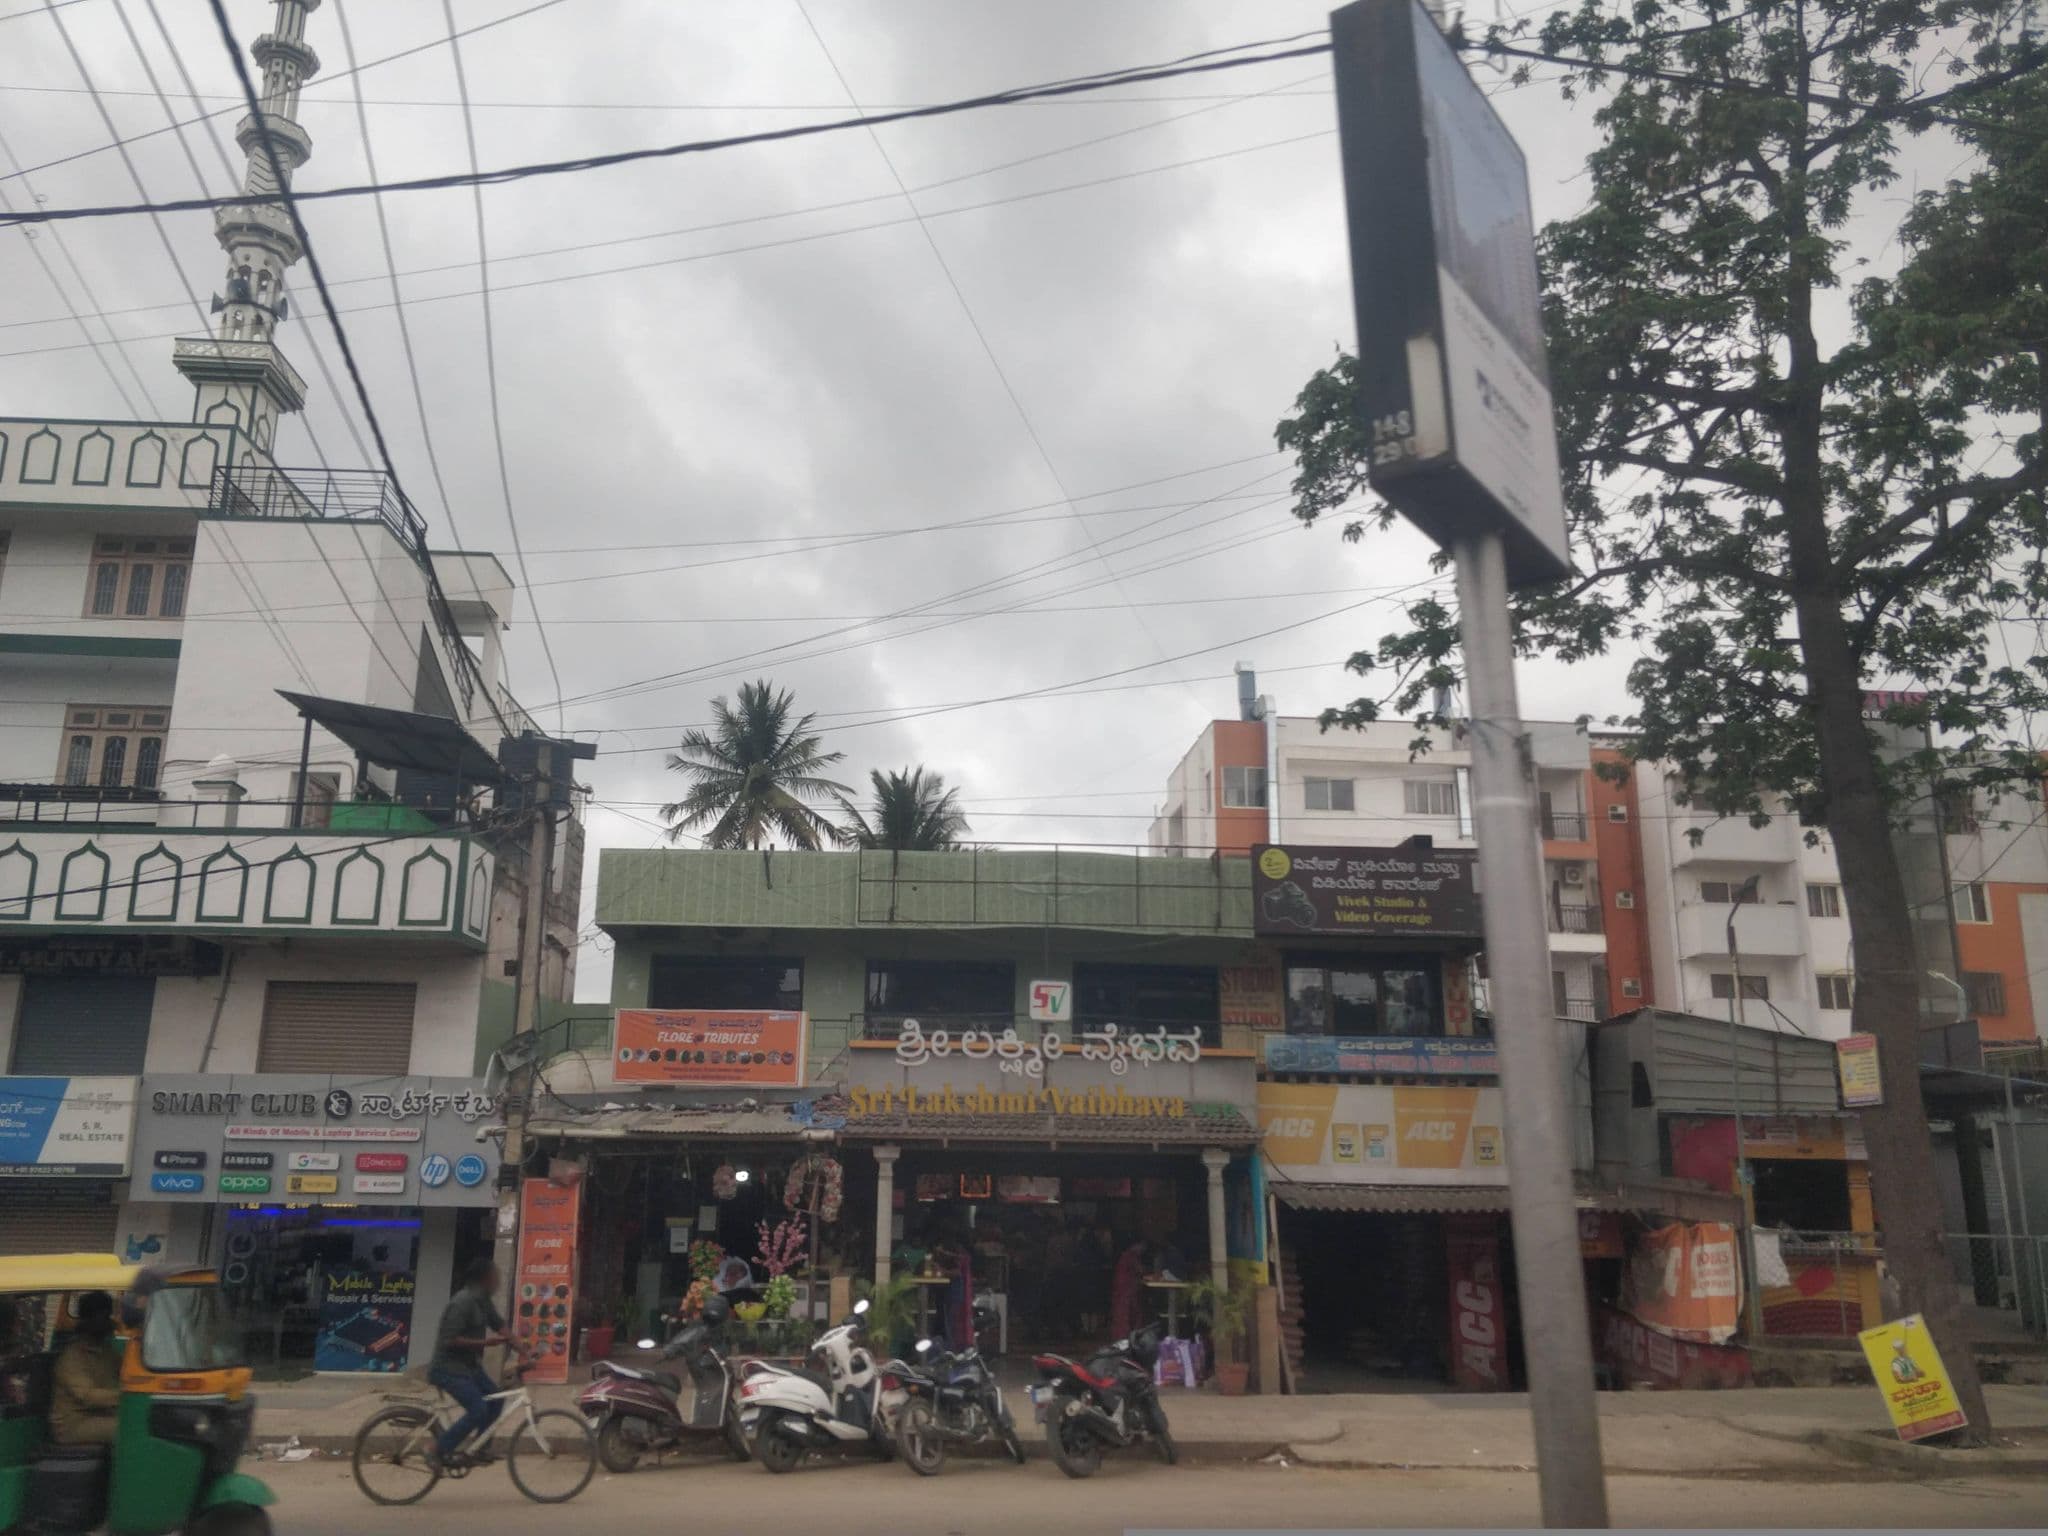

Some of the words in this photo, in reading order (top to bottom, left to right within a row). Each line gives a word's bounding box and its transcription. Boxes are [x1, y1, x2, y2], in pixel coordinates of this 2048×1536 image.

[1337, 896, 1370, 907] Vivek
[1374, 897, 1414, 908] Studio
[1418, 897, 1427, 908] &
[1334, 911, 1370, 923] Video
[1373, 911, 1433, 926] Coverage
[657, 1031, 694, 1043] FLORE
[703, 1032, 760, 1044] TRIBUTES
[896, 1018, 951, 1066] ಶ್ರೀ
[1082, 1022, 1202, 1076] ವೈಭವ
[152, 1091, 241, 1114] SMART
[251, 1093, 316, 1115] CLUB
[849, 1082, 892, 1119] Sri
[902, 1081, 1037, 1114] Lakshmi
[1040, 1083, 1185, 1119] Vaibhava
[354, 1129, 387, 1138] Service
[1267, 1118, 1316, 1137] ACC
[1406, 1120, 1457, 1141] ACC
[59, 1133, 83, 1142] REAL
[88, 1133, 124, 1142] ESTATE
[158, 1177, 195, 1189] vivo
[327, 1273, 374, 1291] Mobile
[327, 1294, 359, 1304] Repair
[371, 1294, 413, 1304] Services
[1456, 1280, 1498, 1384] ACC
